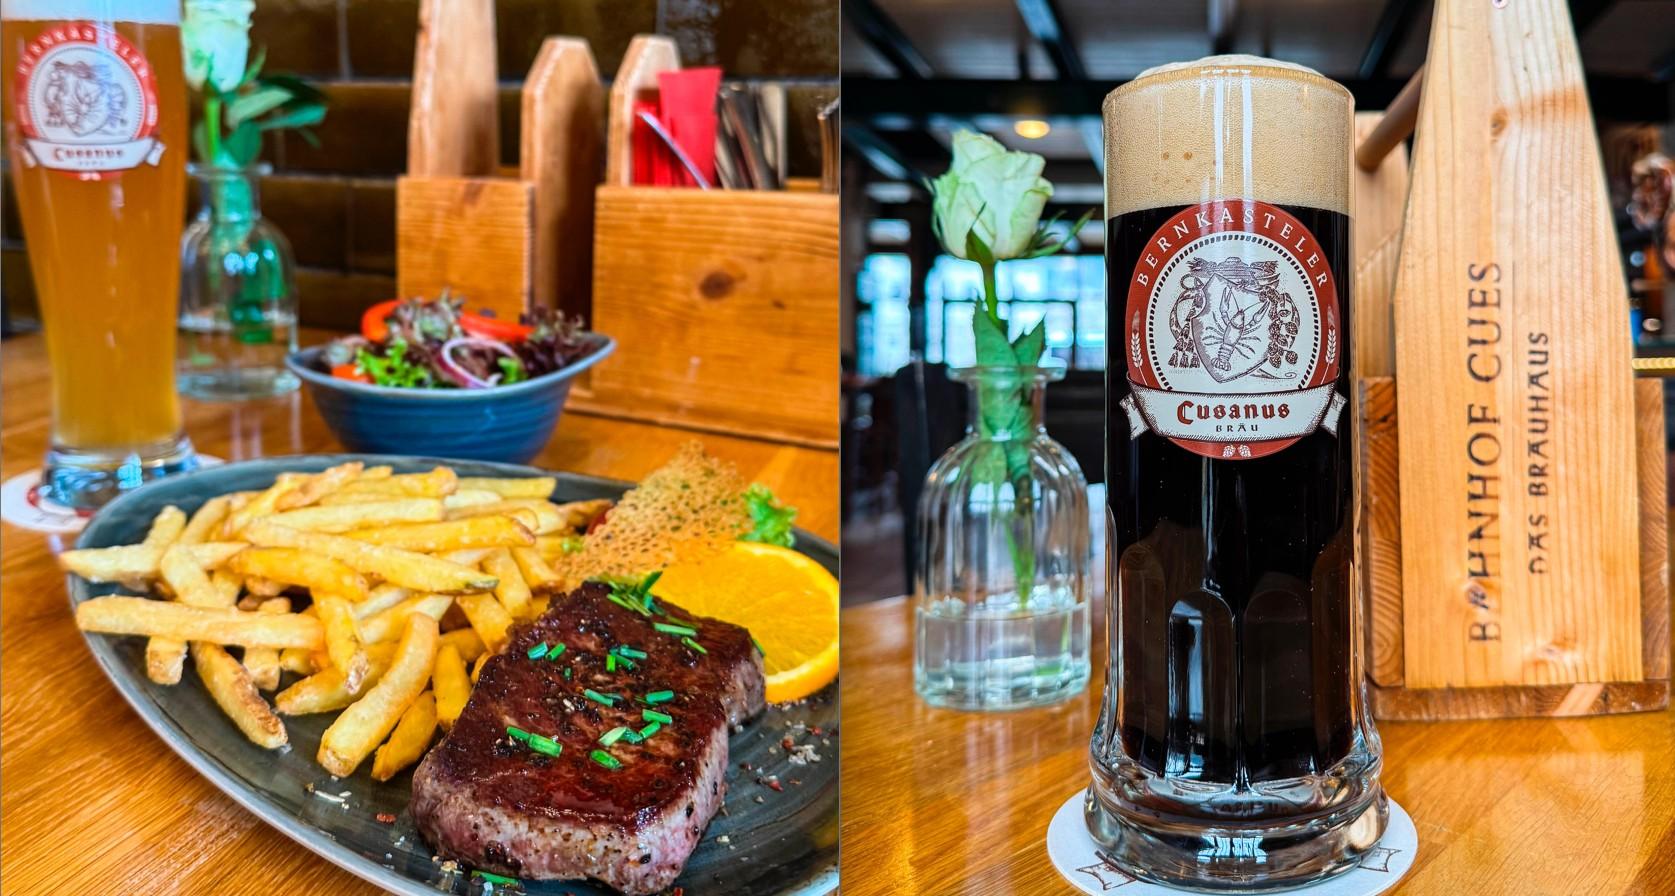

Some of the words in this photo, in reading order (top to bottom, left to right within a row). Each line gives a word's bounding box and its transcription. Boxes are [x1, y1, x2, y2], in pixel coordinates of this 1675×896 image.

[1136, 207, 1329, 287] BERNKASTELER
[1467, 261, 1502, 383] CUES
[1176, 400, 1291, 425] Cusanus
[1215, 422, 1260, 433] BRÄU
[1528, 331, 1550, 497] BRAUHAUS
[1467, 402, 1502, 643] BAHNHOF
[1528, 513, 1549, 575] DAS
